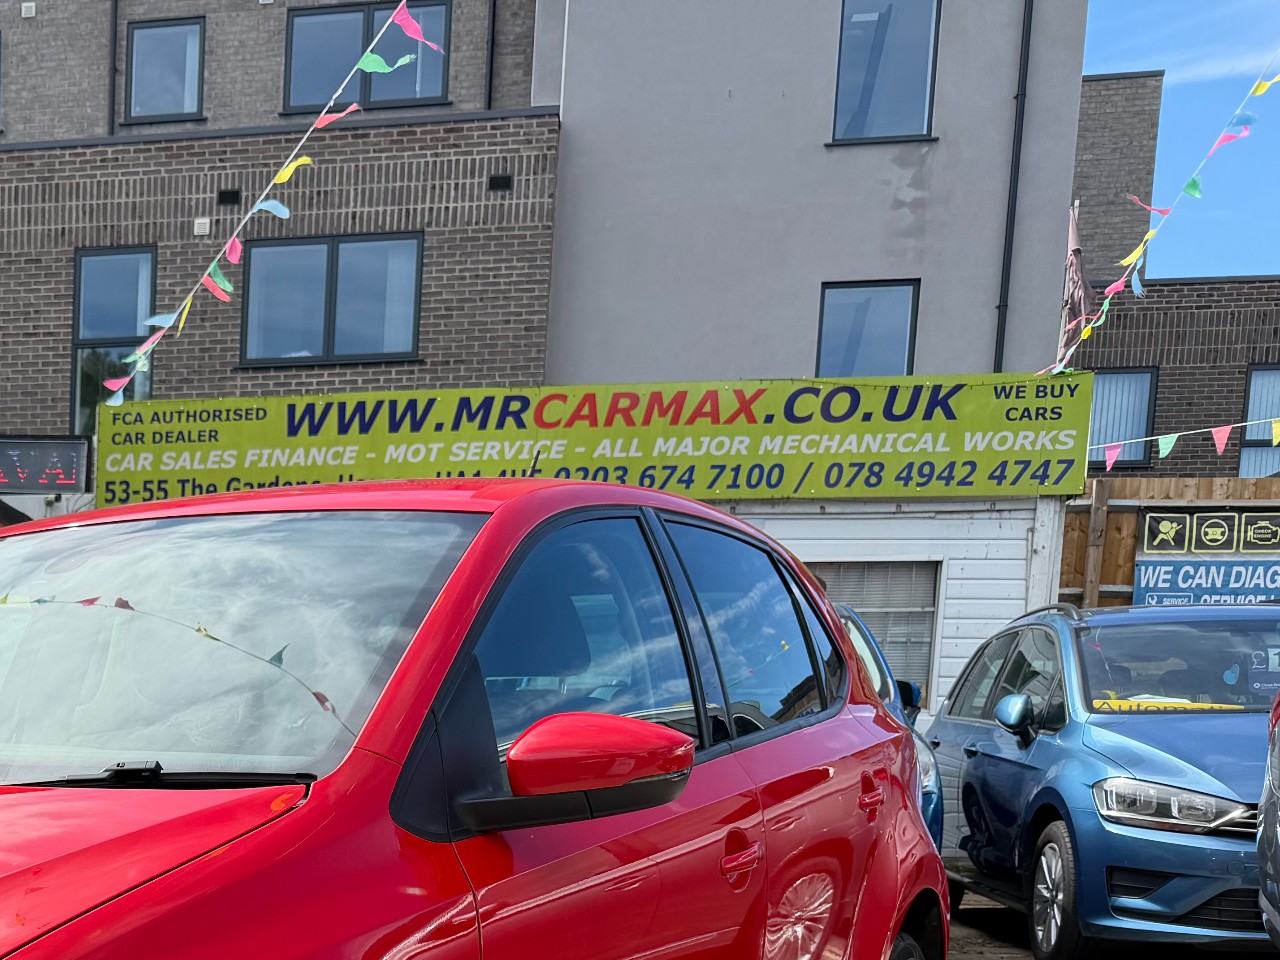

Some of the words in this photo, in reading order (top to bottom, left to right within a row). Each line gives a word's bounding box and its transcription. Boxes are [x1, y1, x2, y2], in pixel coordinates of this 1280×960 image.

[993, 385, 1027, 400] WE
[1035, 383, 1080, 399] BUY
[112, 412, 144, 426] FCA
[150, 408, 267, 425] AUTHORISED
[285, 383, 968, 438] WWW.MRCARMAX.CO.UK
[1005, 406, 1063, 422] CARS
[112, 431, 146, 446] CAR
[152, 430, 219, 445] DEALER
[105, 452, 154, 473] CAR
[160, 450, 238, 471] SALES
[244, 445, 359, 468] FINANCE
[384, 443, 445, 464] MOT
[449, 439, 566, 462] SERVICE
[593, 438, 643, 459] ALL
[652, 436, 750, 457] MAJOR
[759, 432, 950, 456] MECHANICAL
[963, 429, 1077, 452] WORKS
[104, 480, 169, 504] 53-55
[639, 464, 696, 490] 674
[706, 463, 785, 490] 7100
[824, 462, 884, 489] 078
[894, 460, 978, 488] 4942
[986, 458, 1076, 487] 4747
[1140, 566, 1174, 588] WE
[1177, 565, 1225, 588] CAN
[1229, 565, 1280, 588] DIAG
